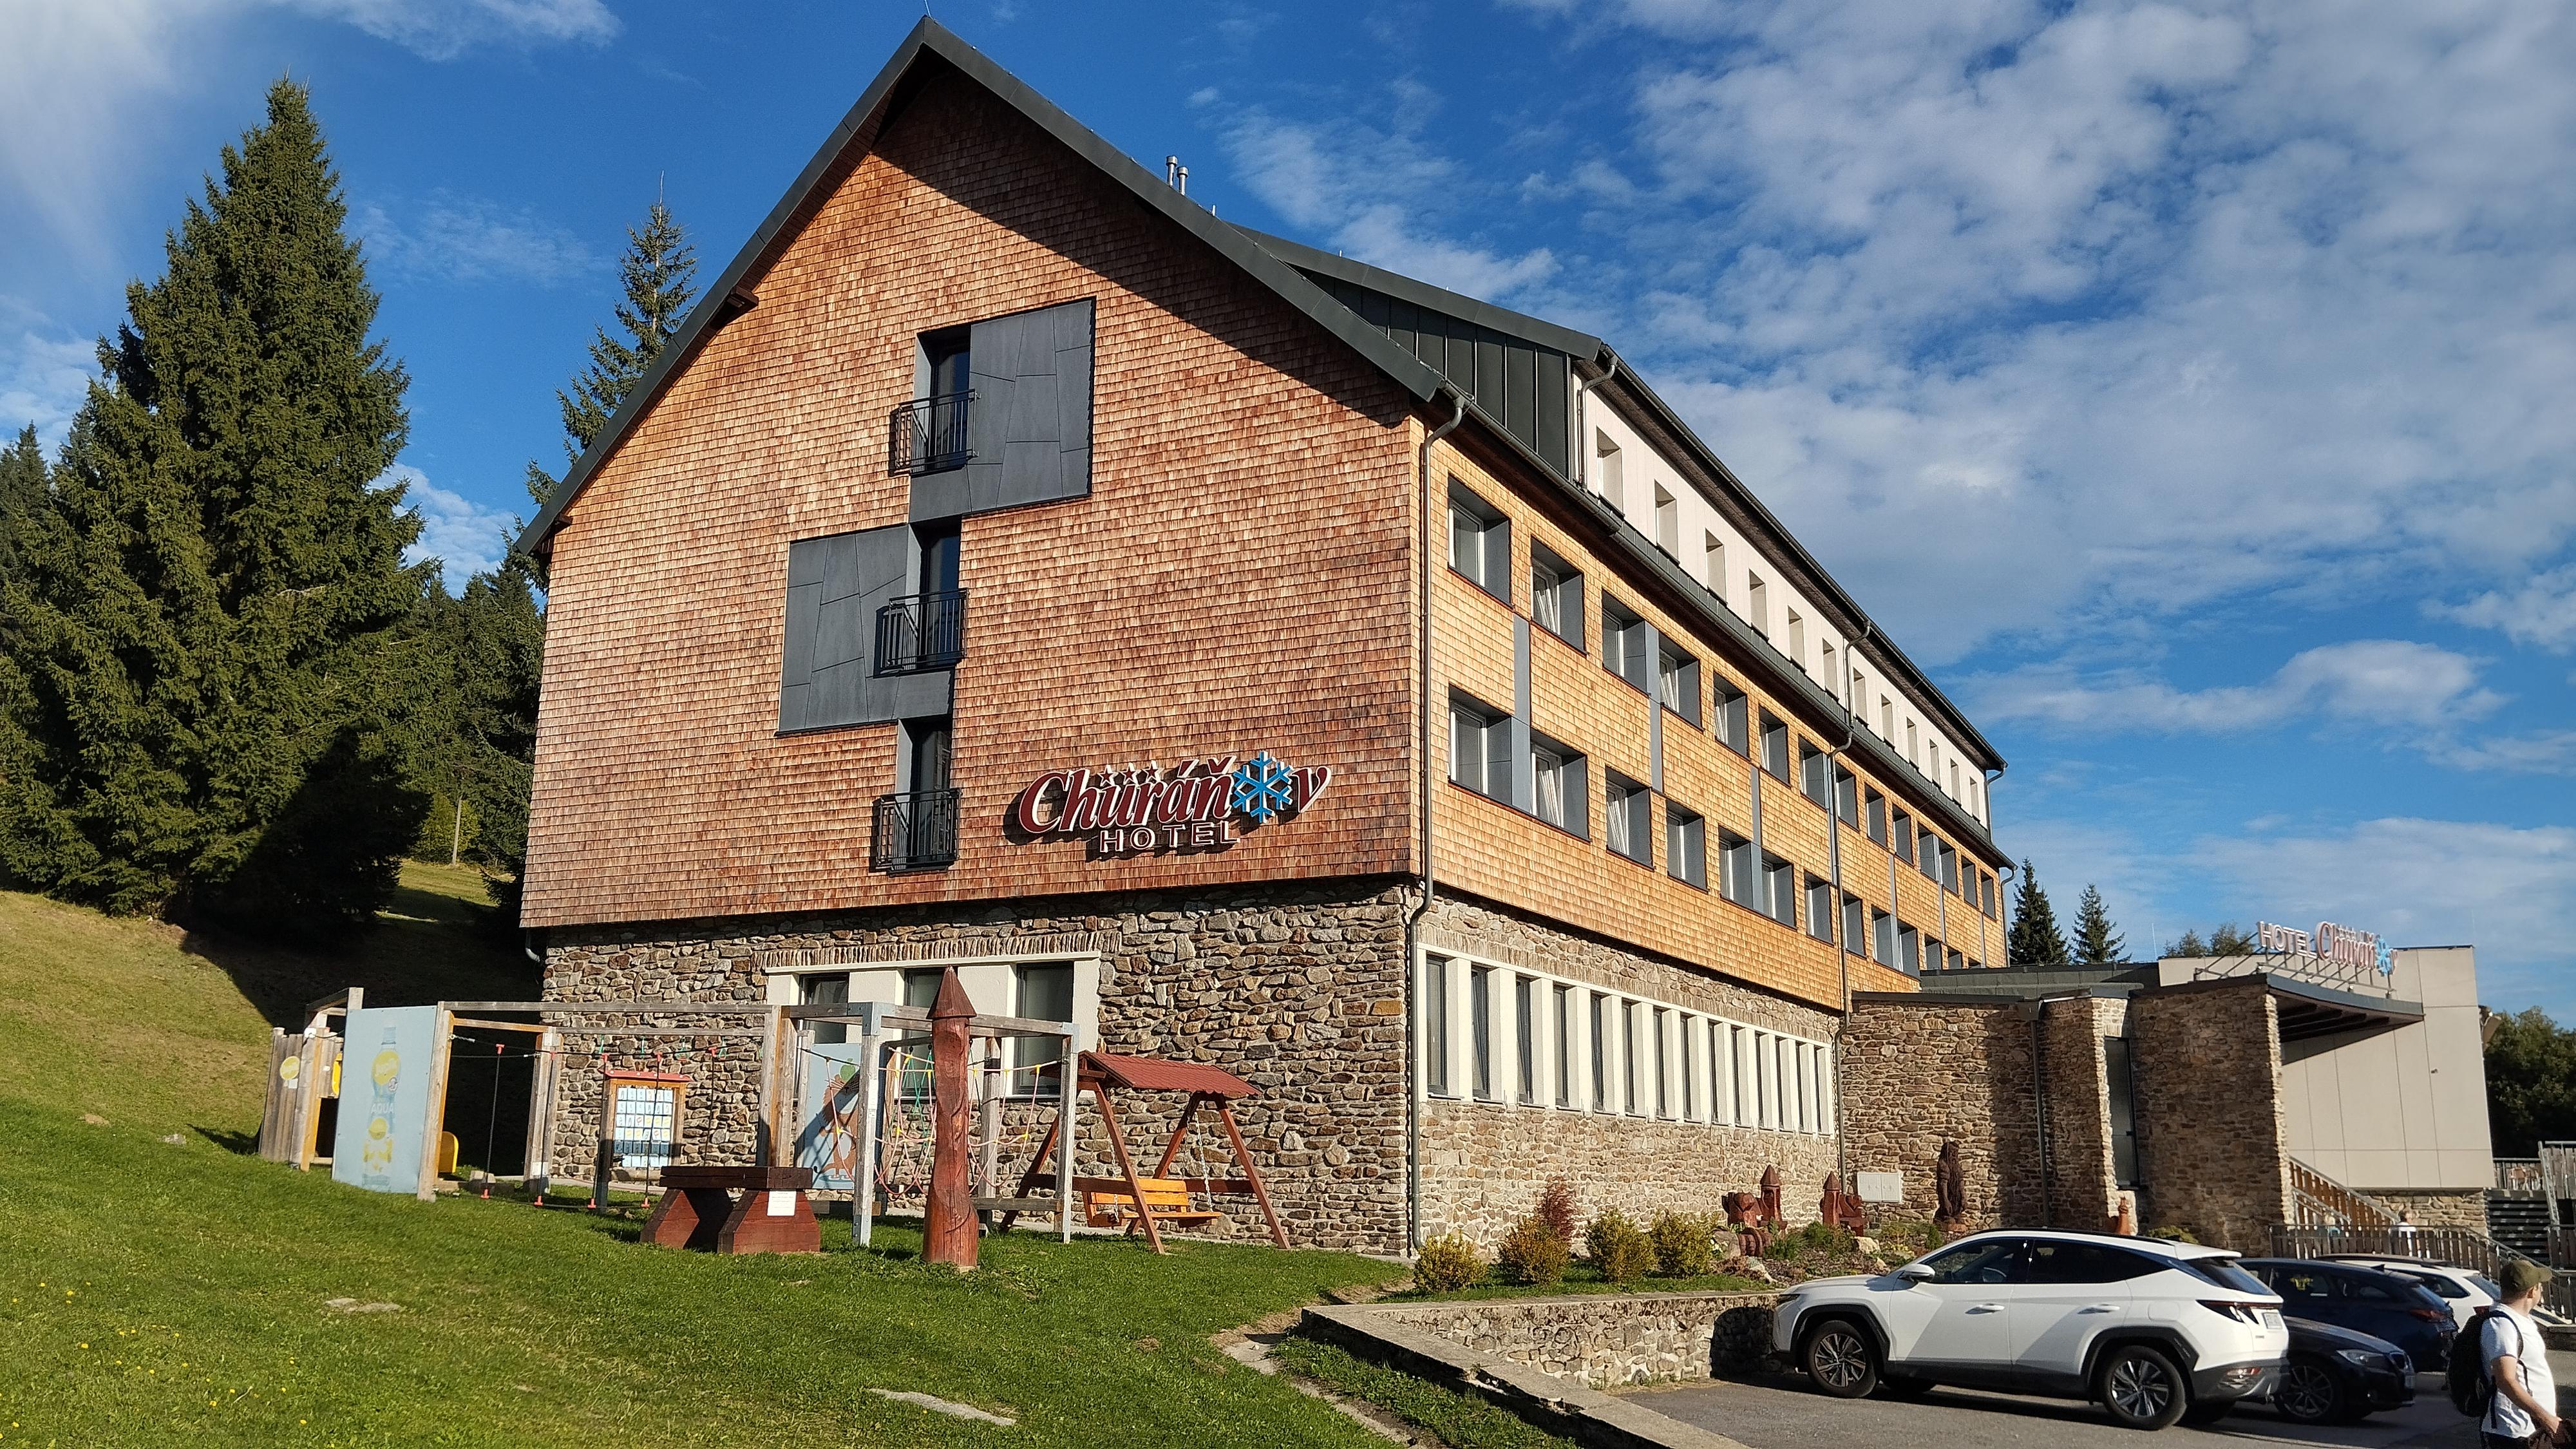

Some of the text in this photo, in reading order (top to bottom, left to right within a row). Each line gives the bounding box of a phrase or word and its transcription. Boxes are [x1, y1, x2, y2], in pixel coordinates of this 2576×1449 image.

[1019, 752, 1332, 833] Churáňv
[1100, 820, 1240, 853] HOTEL
[2257, 921, 2398, 976] HOTEL Churáňv
